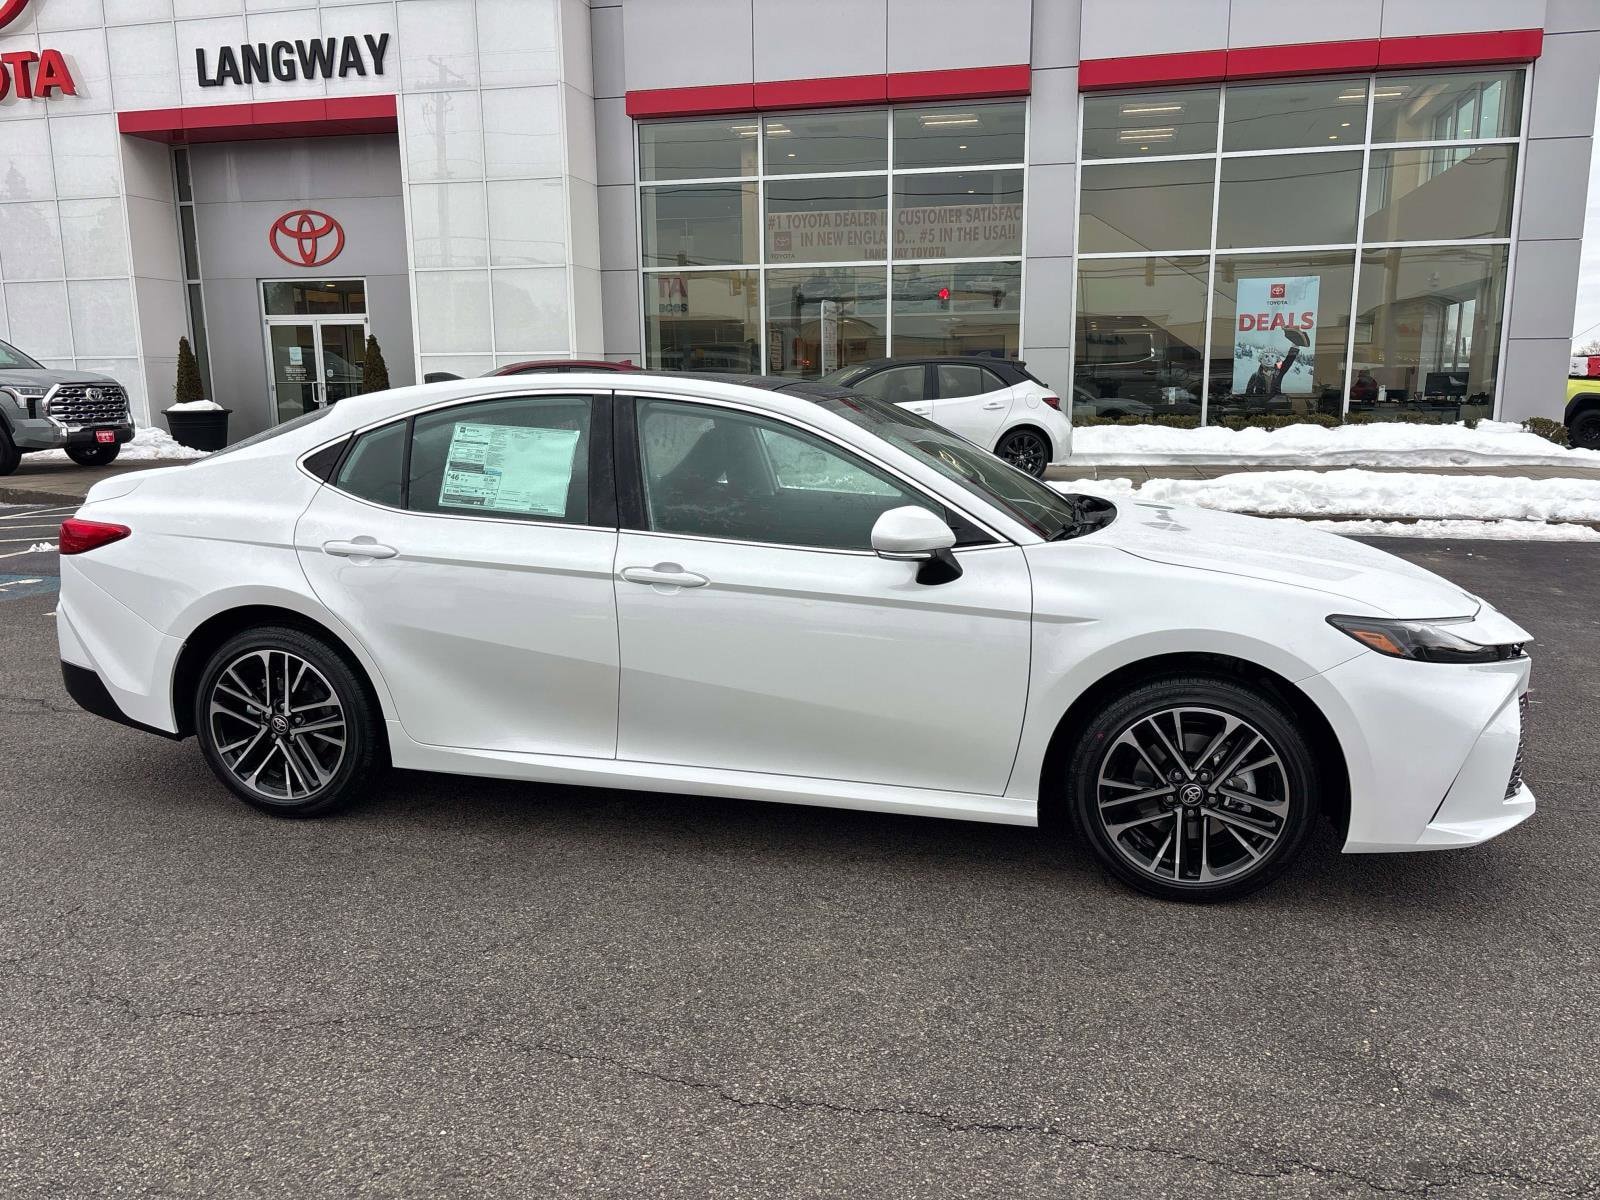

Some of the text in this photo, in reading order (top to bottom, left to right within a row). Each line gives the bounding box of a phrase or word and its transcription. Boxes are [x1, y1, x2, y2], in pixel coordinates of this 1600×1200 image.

[196, 33, 389, 86] LANGWAY
[0, 48, 78, 100] TA
[768, 215, 782, 231] #1
[786, 213, 832, 230] TOYOTA
[835, 211, 877, 228] DEALER
[898, 208, 962, 225] CUSTOMER
[800, 232, 814, 247] IN
[817, 231, 843, 246] NEW
[920, 228, 935, 243] #5
[940, 228, 952, 242] IN
[957, 227, 979, 241] THE
[983, 224, 1016, 240] USA!!
[912, 246, 946, 258] TOYOTA
[1239, 312, 1314, 331] DEALS
